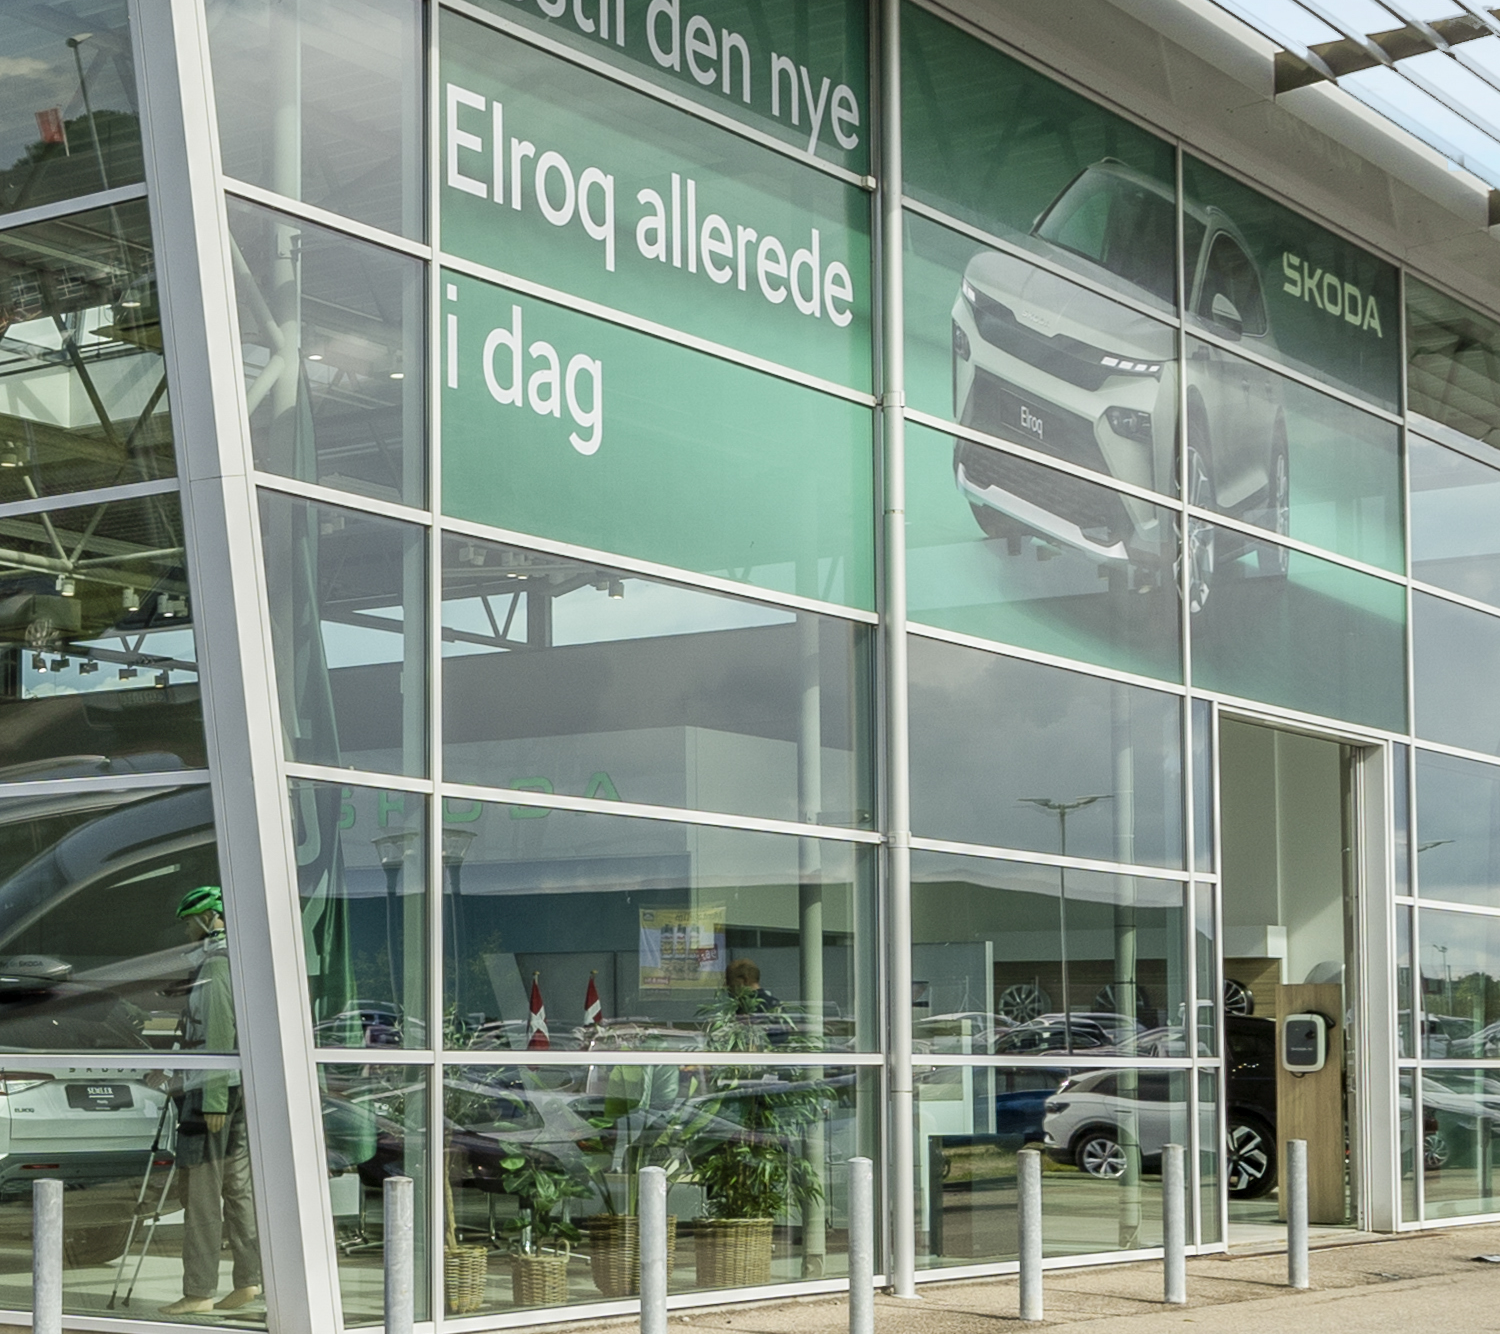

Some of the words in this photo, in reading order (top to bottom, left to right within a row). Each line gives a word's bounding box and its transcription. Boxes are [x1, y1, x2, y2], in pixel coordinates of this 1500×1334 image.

[771, 51, 860, 156] nye
[446, 82, 615, 272] Elroq
[636, 172, 854, 328] allerede
[1282, 251, 1383, 338] SKODA
[446, 283, 459, 389] i
[482, 305, 604, 456] dag
[1021, 405, 1044, 440] Elroq
